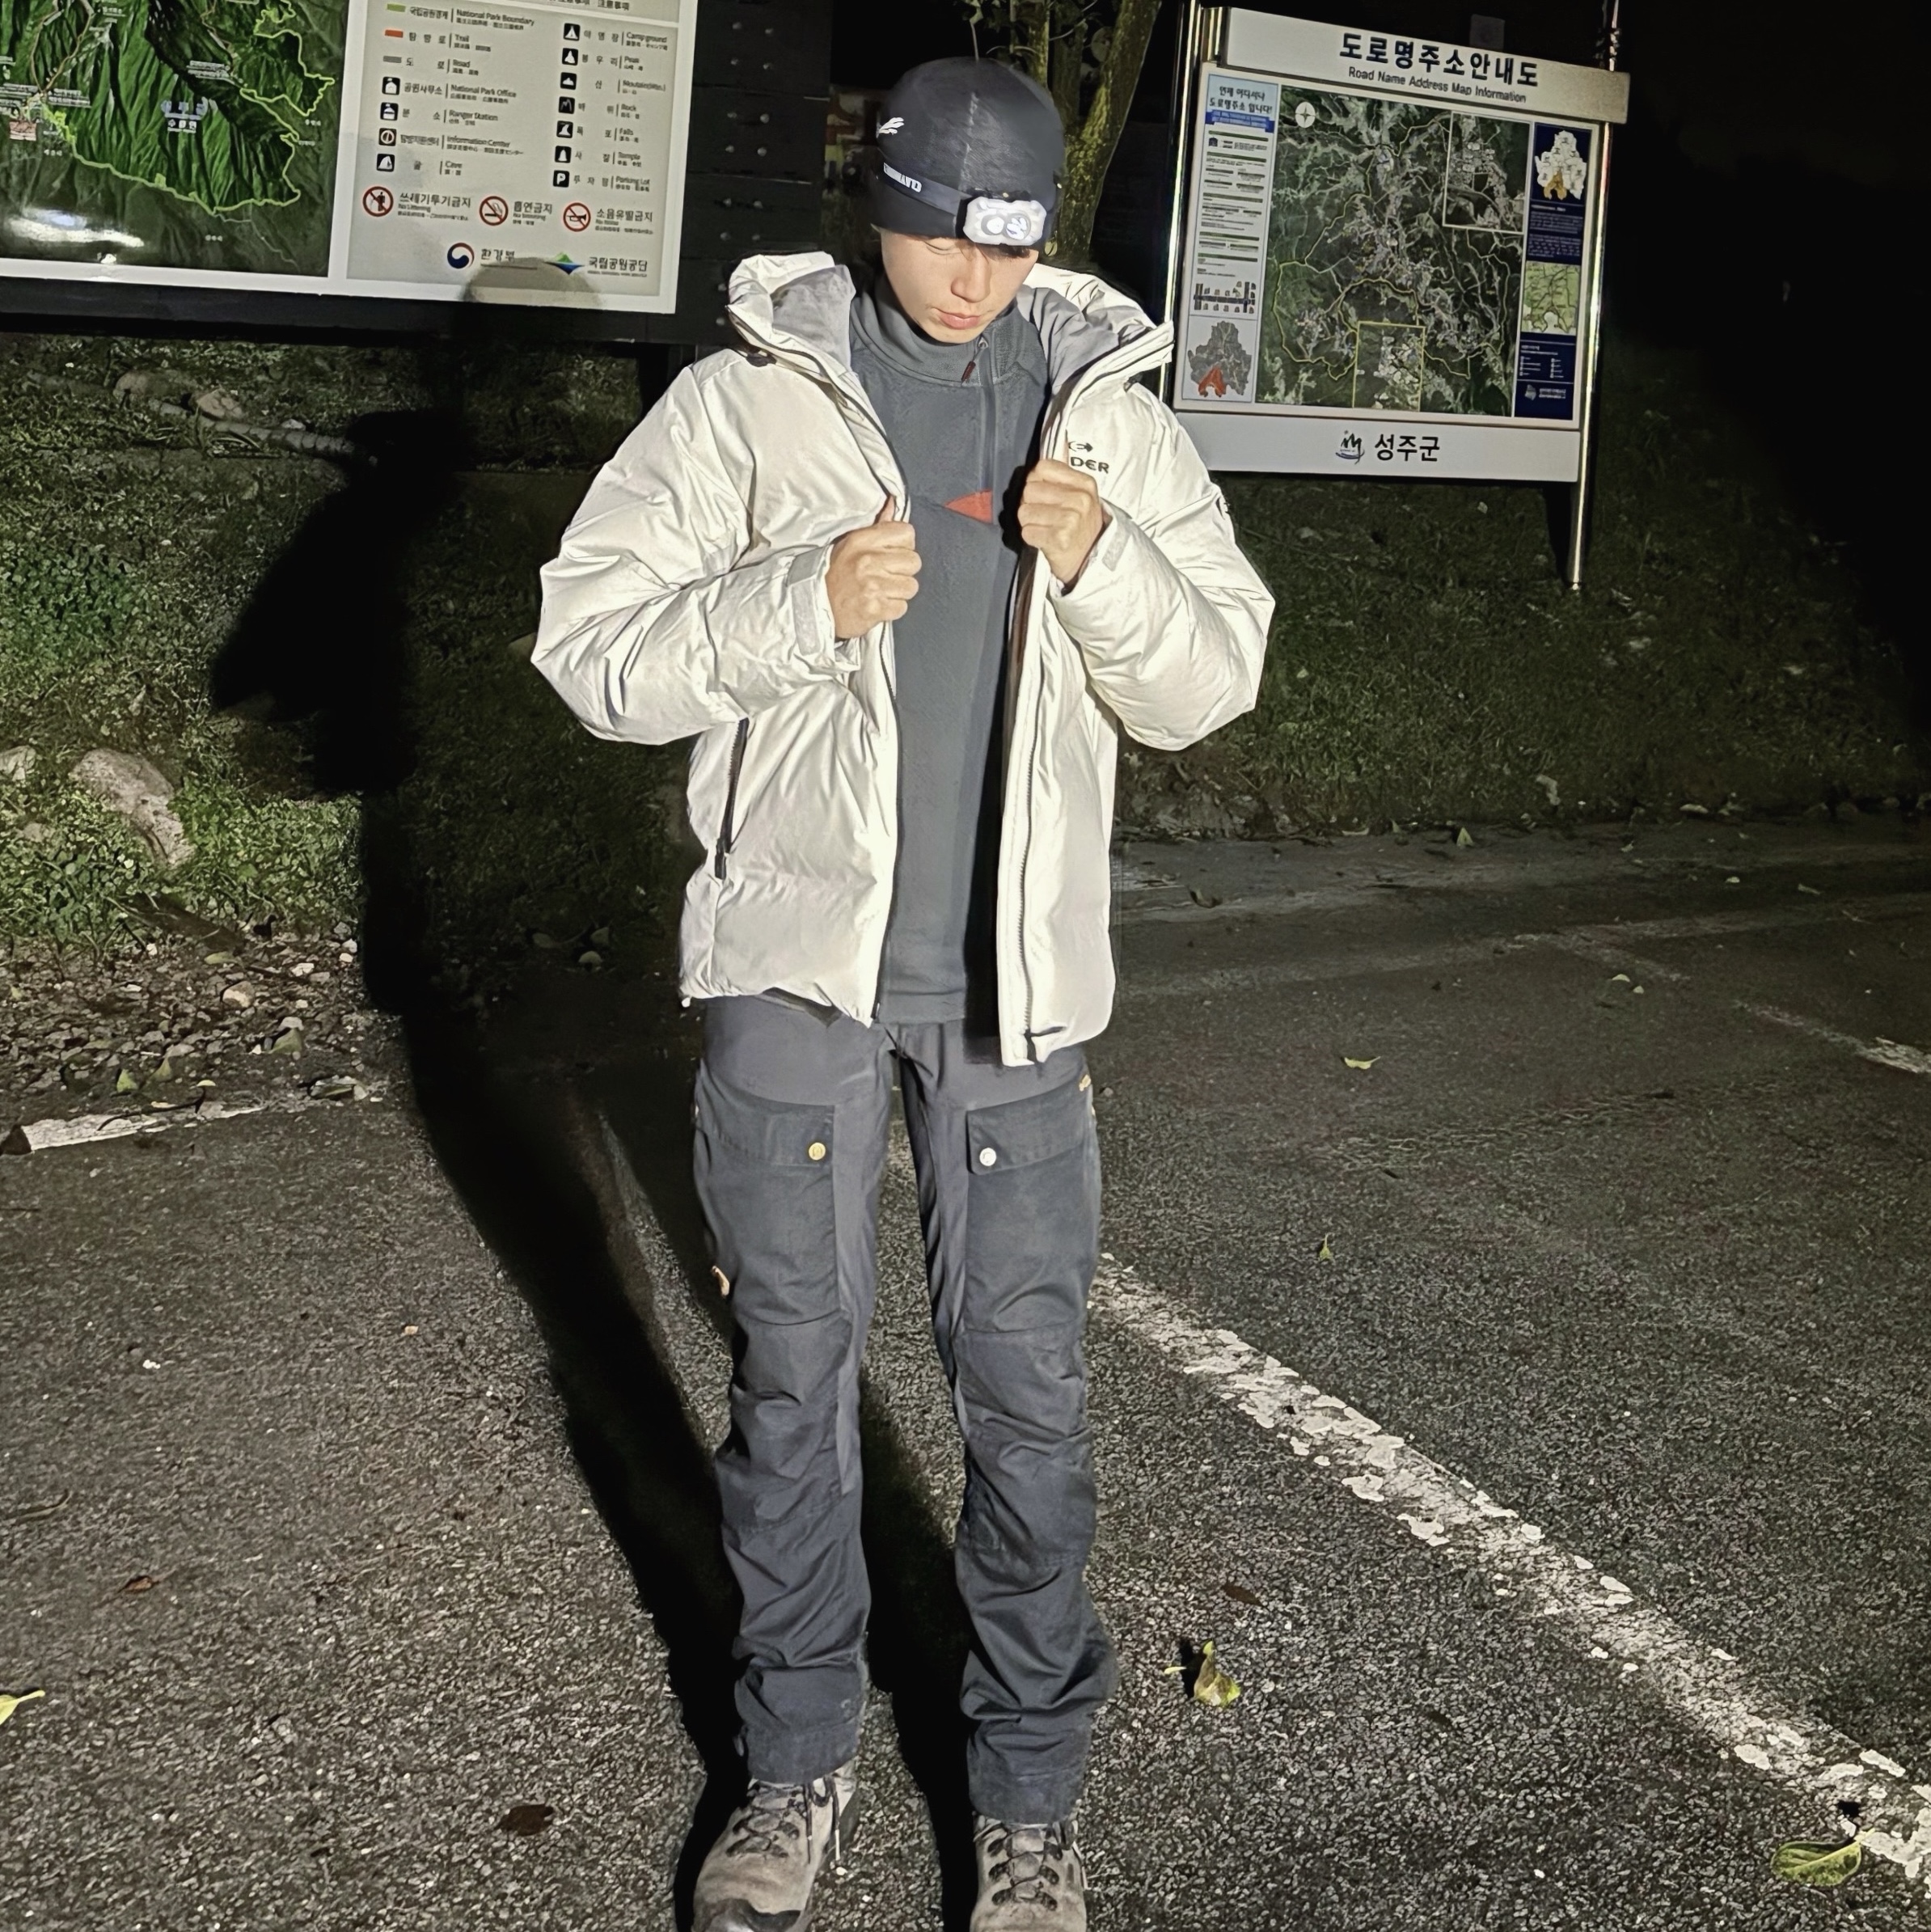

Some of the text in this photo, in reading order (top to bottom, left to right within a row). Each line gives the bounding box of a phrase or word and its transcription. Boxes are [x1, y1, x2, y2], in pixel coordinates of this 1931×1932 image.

[457, 9, 484, 19] National
[487, 12, 501, 21] Park
[1339, 32, 1539, 87] 도로명주소안내도
[450, 84, 517, 98] National Park Office
[1349, 66, 1527, 104] Road Name Address Map Information
[399, 192, 471, 209] 쓰레기투기금지
[513, 201, 552, 215] 흡연금지
[596, 209, 653, 222] 소음유발금지
[589, 256, 648, 273] 국립공원공단
[1375, 433, 1440, 462] 성주군
[1070, 456, 1109, 474] DER
